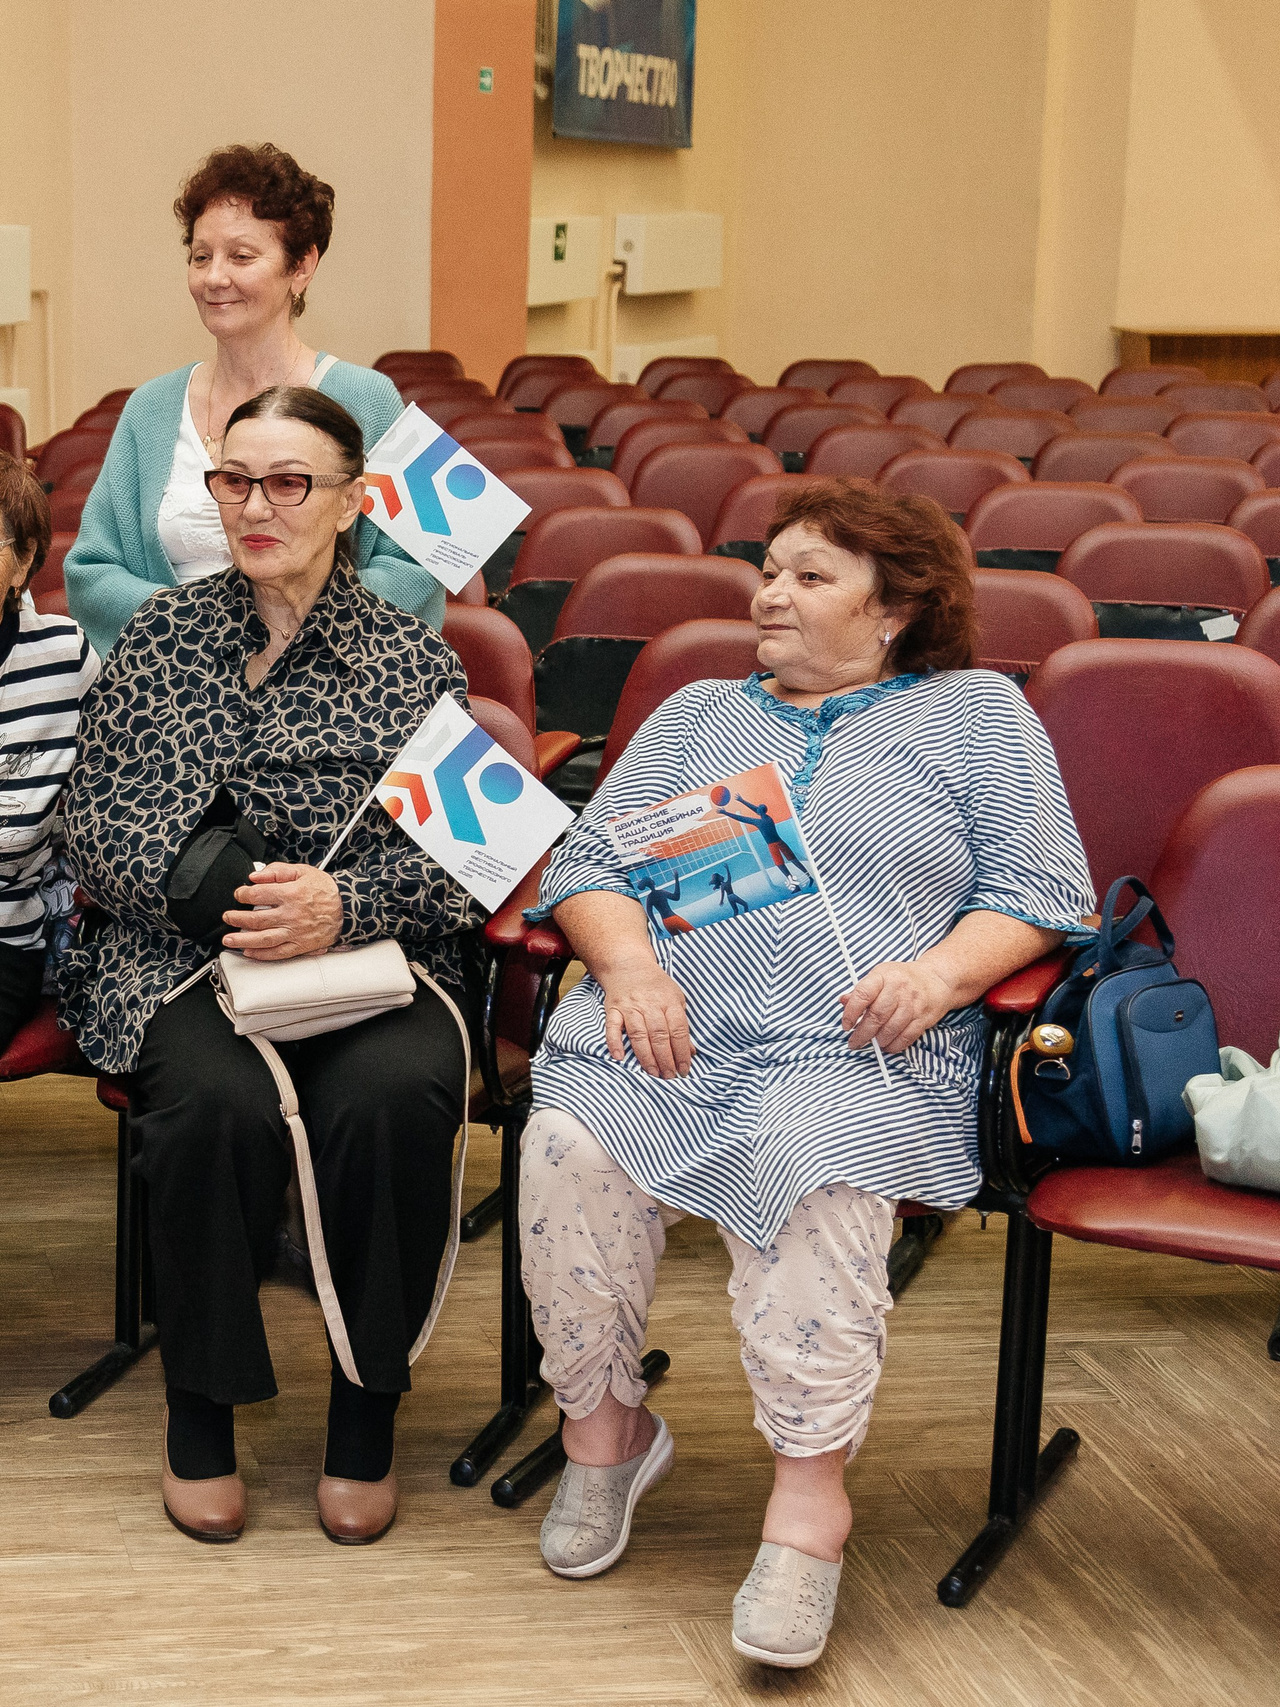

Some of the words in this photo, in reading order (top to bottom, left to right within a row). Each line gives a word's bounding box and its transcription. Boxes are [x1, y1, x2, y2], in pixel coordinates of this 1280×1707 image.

[577, 43, 677, 108] ТВОРЧЕСТВО
[614, 807, 669, 833] ДВИЖЕНИЕ
[617, 826, 648, 841] НАША
[649, 806, 704, 830] СЕМЕЙНАЯ
[621, 826, 675, 849] ТРАДИЦИЯ
[466, 859, 512, 883] ПРОФСОЮЗНОГО
[470, 854, 504, 873] ФЕСТИВАЛЬ
[474, 849, 518, 872] РЕГИОНАЛЬНЫЙ
[462, 864, 497, 884] ТВОРЧЕСТВА
